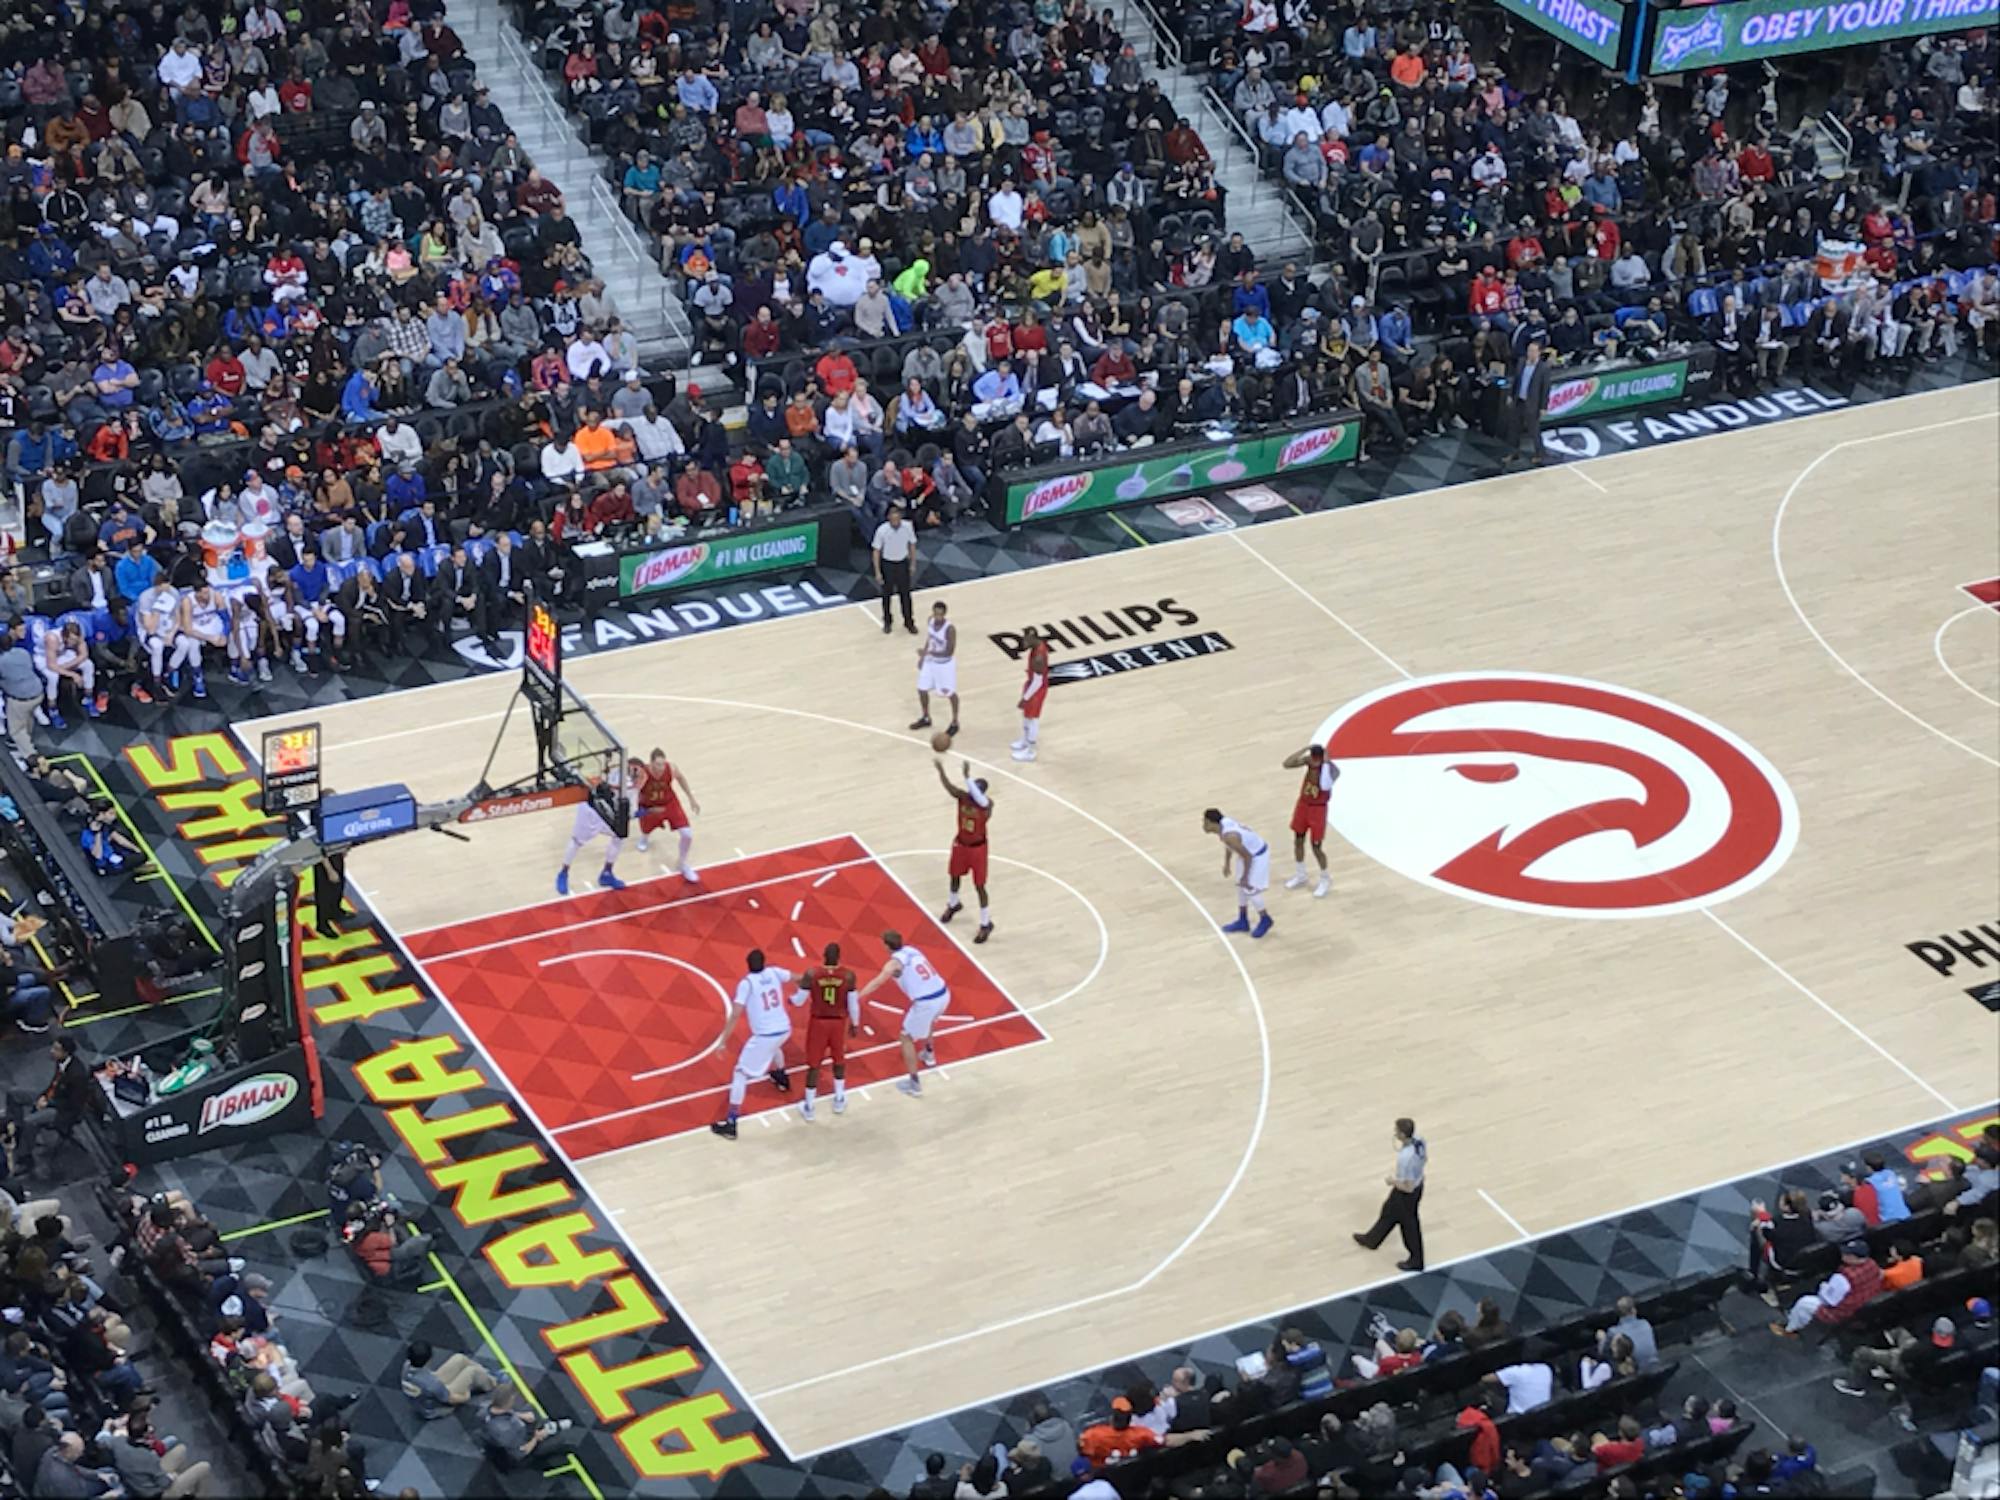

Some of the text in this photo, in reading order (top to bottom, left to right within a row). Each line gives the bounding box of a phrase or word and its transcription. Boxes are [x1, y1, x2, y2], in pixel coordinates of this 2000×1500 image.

[1740, 7, 1823, 45] OBEY
[1826, 0, 1905, 34] YOUR
[1630, 373, 1677, 394] CLEANING
[1606, 387, 1849, 444] FANDUEL
[1278, 428, 1341, 470] LIBMAN
[1023, 474, 1088, 518] LIBMAN
[634, 546, 704, 588] LIBMAN
[715, 536, 807, 568] #1 IN CLEANING
[560, 581, 847, 652] FANDUEL
[988, 598, 1199, 660] PHILIPS
[1091, 632, 1230, 677] ARENA
[344, 818, 393, 837] Corona
[1904, 920, 1999, 977] PHI
[761, 988, 780, 1011] 13
[824, 987, 836, 1005] 4
[203, 1081, 289, 1127] LIBMAN
[353, 1034, 771, 1481] ATLANTA
